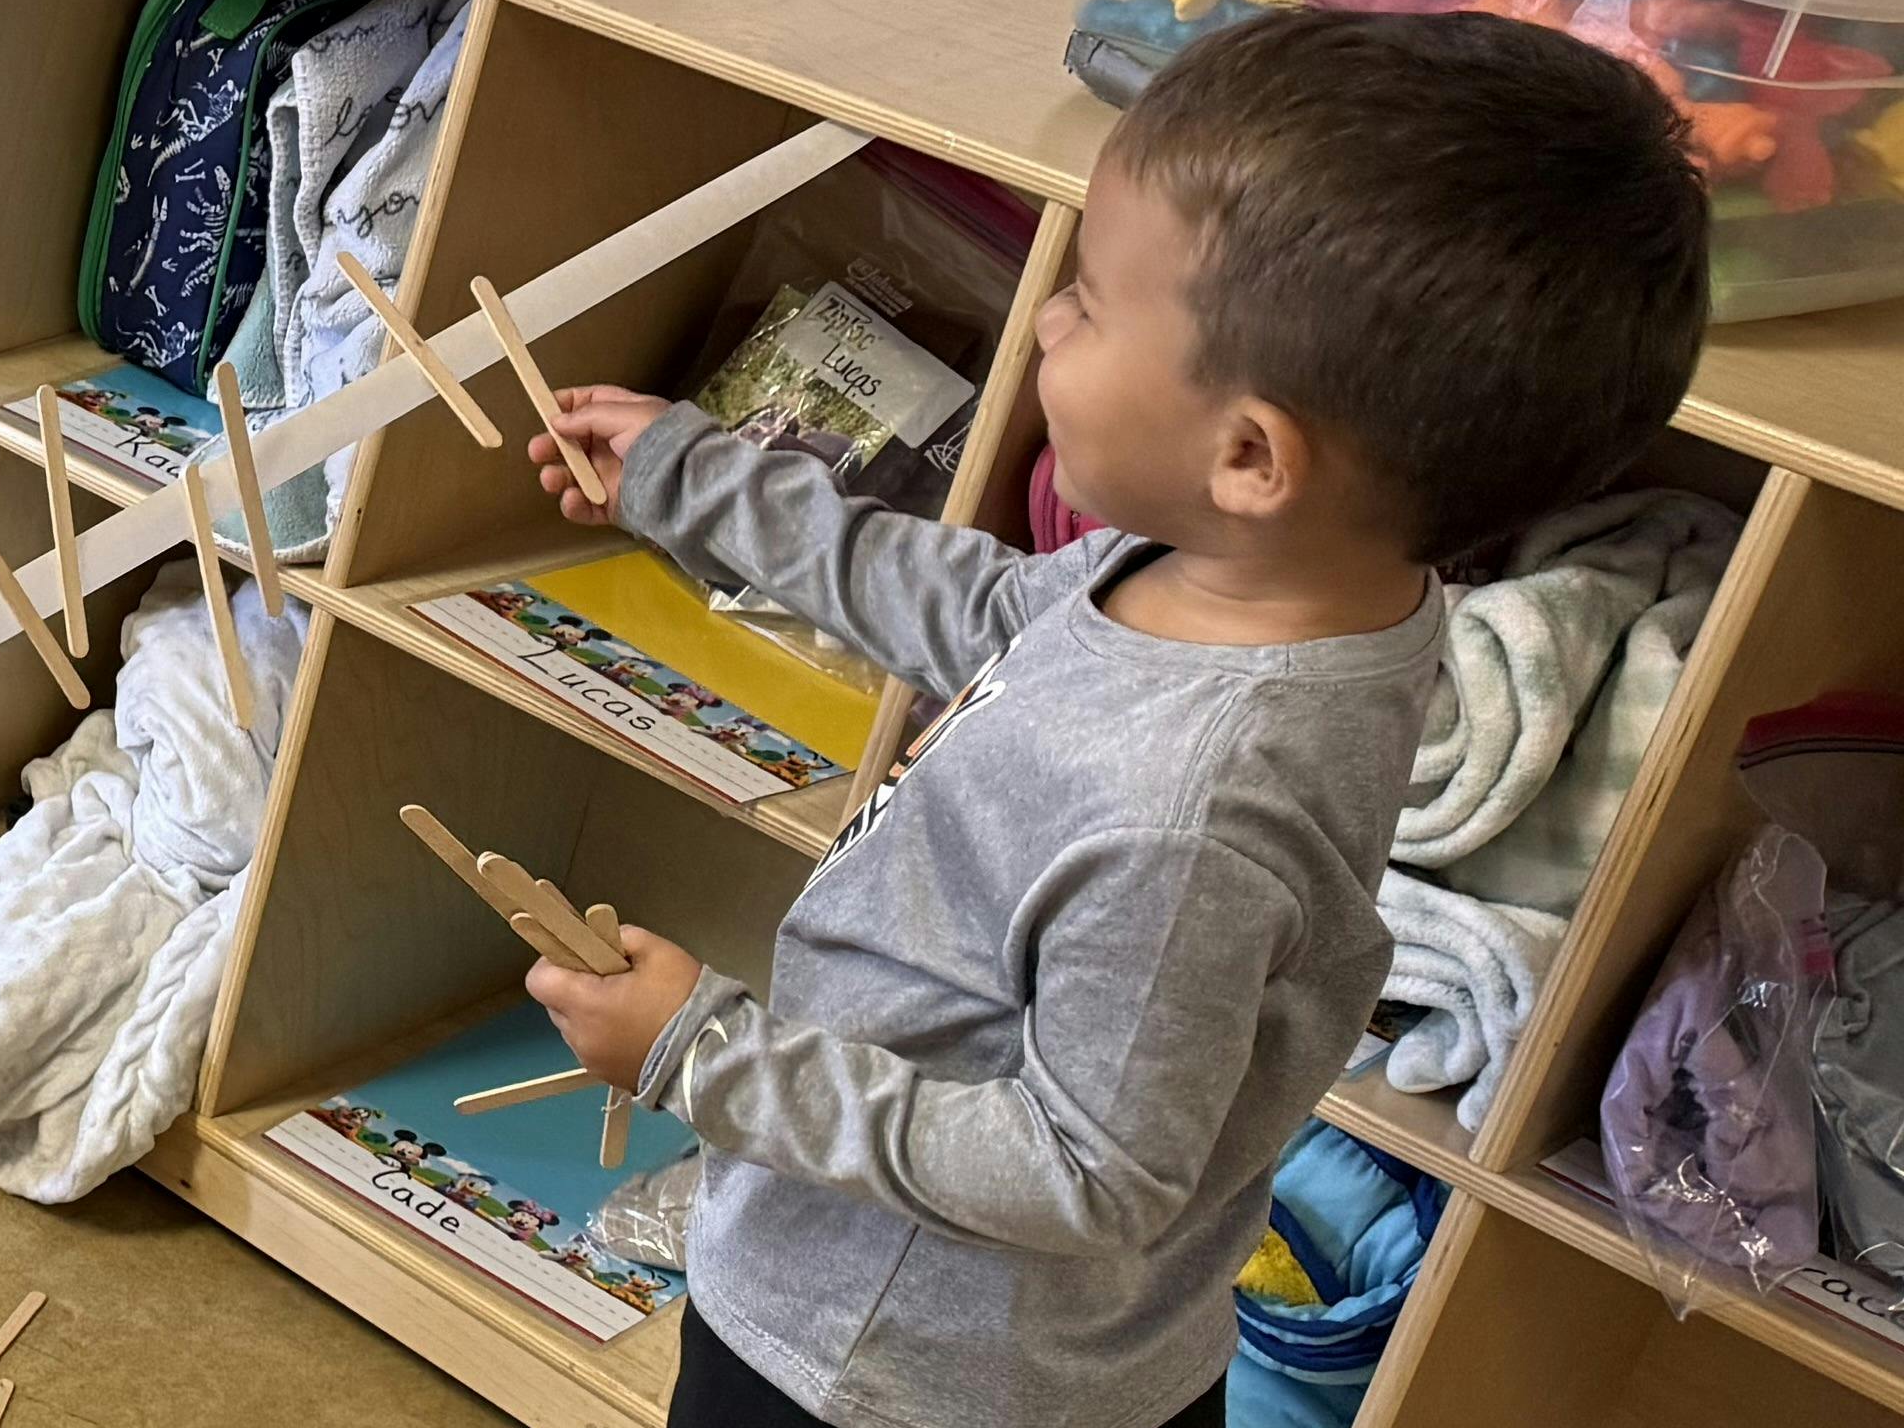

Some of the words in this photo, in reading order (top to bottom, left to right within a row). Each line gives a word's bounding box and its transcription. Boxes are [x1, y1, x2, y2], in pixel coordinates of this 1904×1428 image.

[820, 342, 883, 398] Lucas
[518, 646, 657, 731] Lucas
[372, 1169, 461, 1234] Cade
